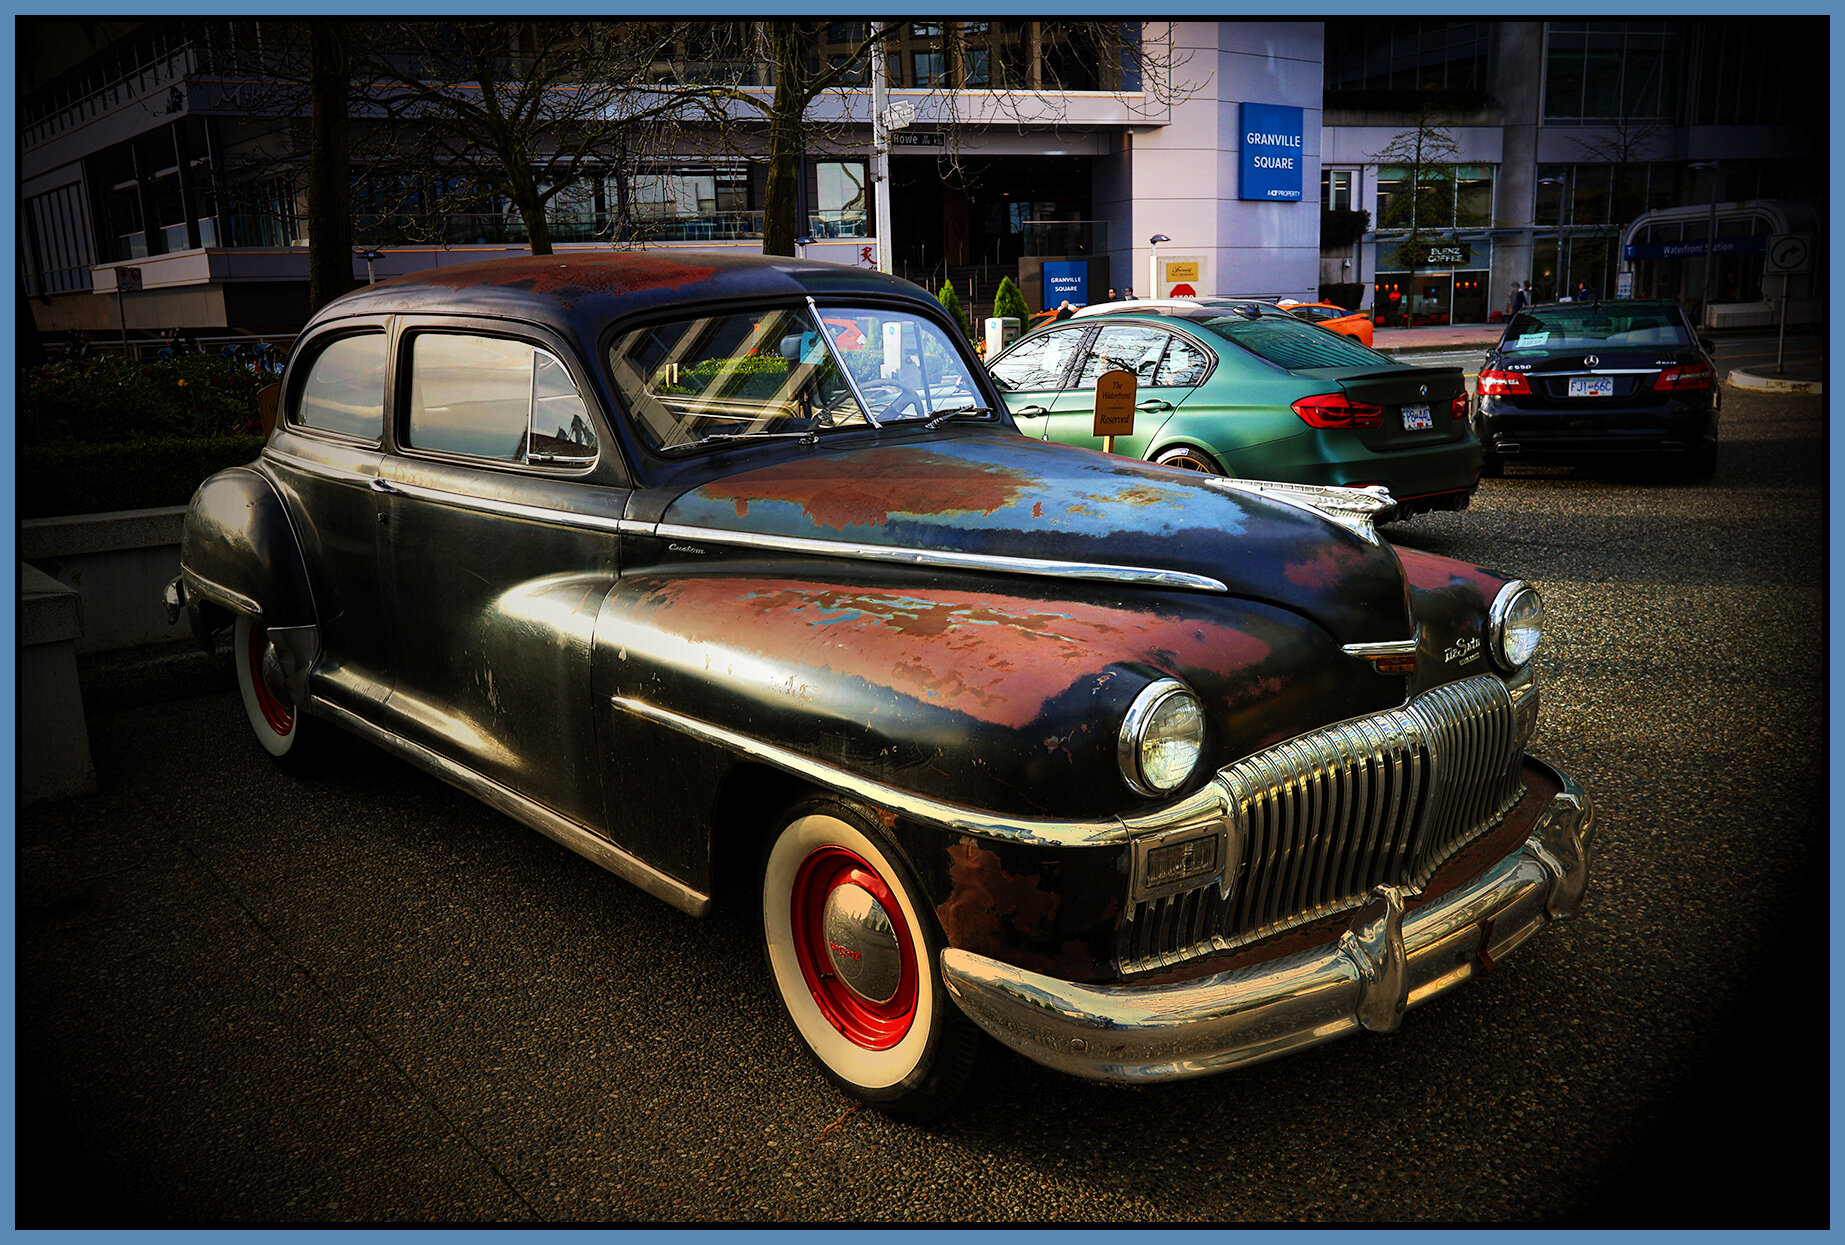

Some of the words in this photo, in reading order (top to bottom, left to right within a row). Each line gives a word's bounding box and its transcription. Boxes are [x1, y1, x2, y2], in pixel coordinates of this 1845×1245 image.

[893, 134, 918, 145] Howe
[1247, 132, 1301, 148] GRANVILLE
[1254, 156, 1294, 170] SQUARE
[1278, 190, 1301, 198] PROPERTY
[1663, 243, 1704, 256] Waterfront
[1050, 276, 1082, 284] GRANVILLE
[1054, 285, 1078, 293] SQUARE
[1113, 381, 1123, 390] The
[1102, 391, 1132, 402] Waterfront
[1099, 413, 1130, 425] Reserved
[668, 543, 706, 555] Custom
